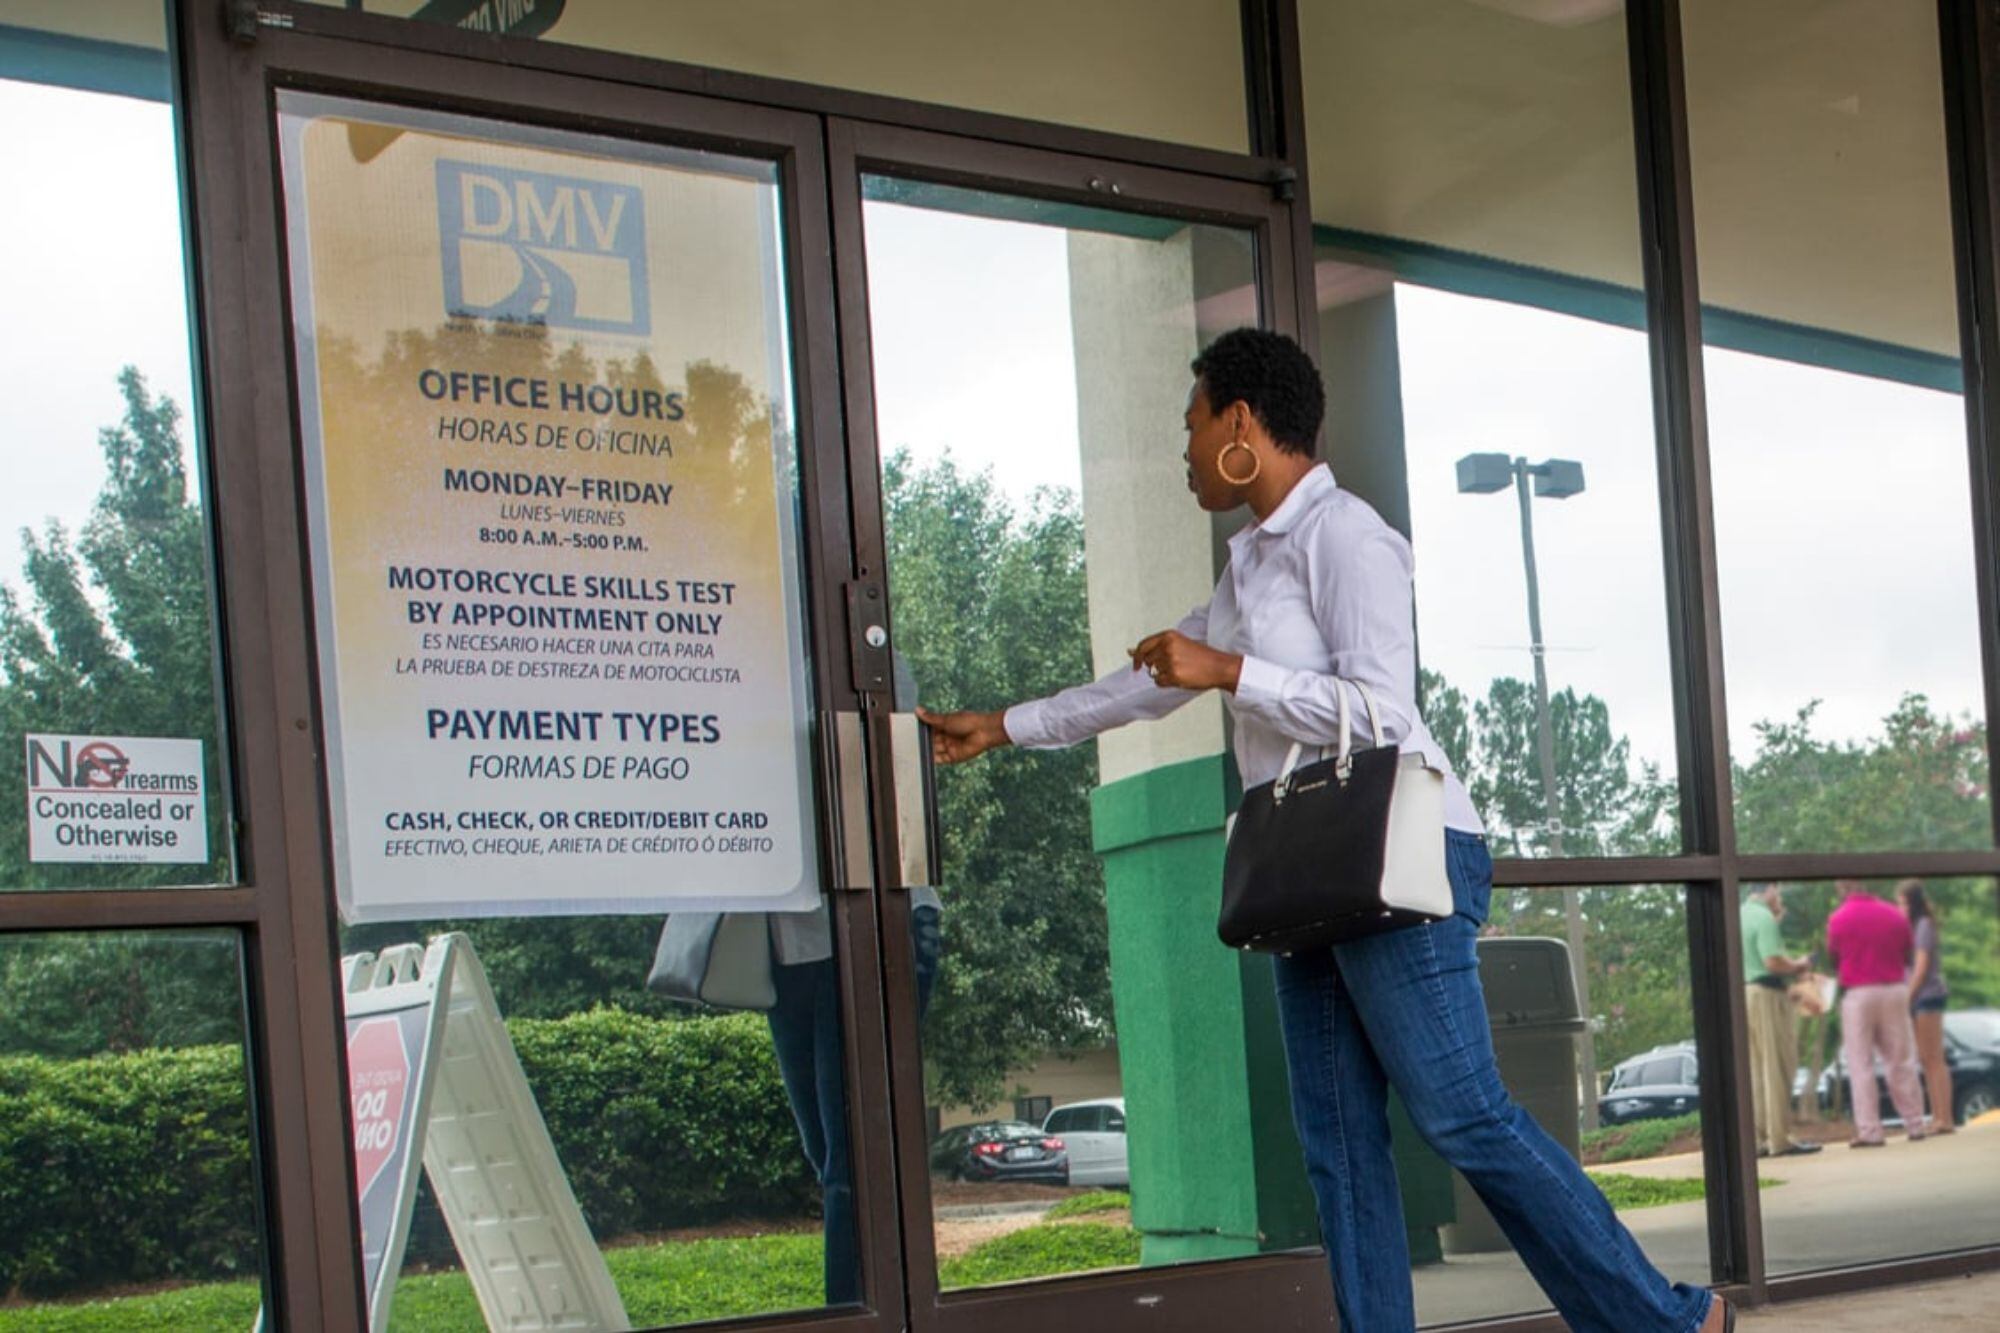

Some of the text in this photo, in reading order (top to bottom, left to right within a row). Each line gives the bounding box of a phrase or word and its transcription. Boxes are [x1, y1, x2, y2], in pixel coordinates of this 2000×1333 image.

[459, 172, 627, 250] DMV
[419, 370, 684, 420] OFFICE HOURS
[438, 417, 672, 458] HORAS DE OFICINA
[479, 528, 517, 545] 8:00
[614, 535, 648, 552] P.M.
[389, 567, 736, 604] MOTORCYCLE SKILLS TEST
[409, 602, 722, 635] BY APPOINTMENT ONLY
[423, 634, 714, 659] ES NECESARIO HACER UNA CITA PARA
[396, 659, 741, 684] LA PRUEBA DE DESTREZA DE MOTOCICLISTA
[427, 709, 720, 743] PAYMENT TYPES
[469, 755, 689, 780] FORMAS DE PAGO
[36, 796, 194, 820] Concealed or
[385, 811, 768, 832] CASH, CHECK, OR CREDIT/DEBIT CARD
[56, 824, 177, 846] Otherwise
[385, 839, 468, 857] EFECTIVO,
[473, 838, 544, 856] CHEQUE,
[548, 837, 602, 854] ARIETA
[607, 837, 627, 853] DE
[632, 835, 698, 853] CRÉDITO
[719, 836, 773, 853] DÉBITO
